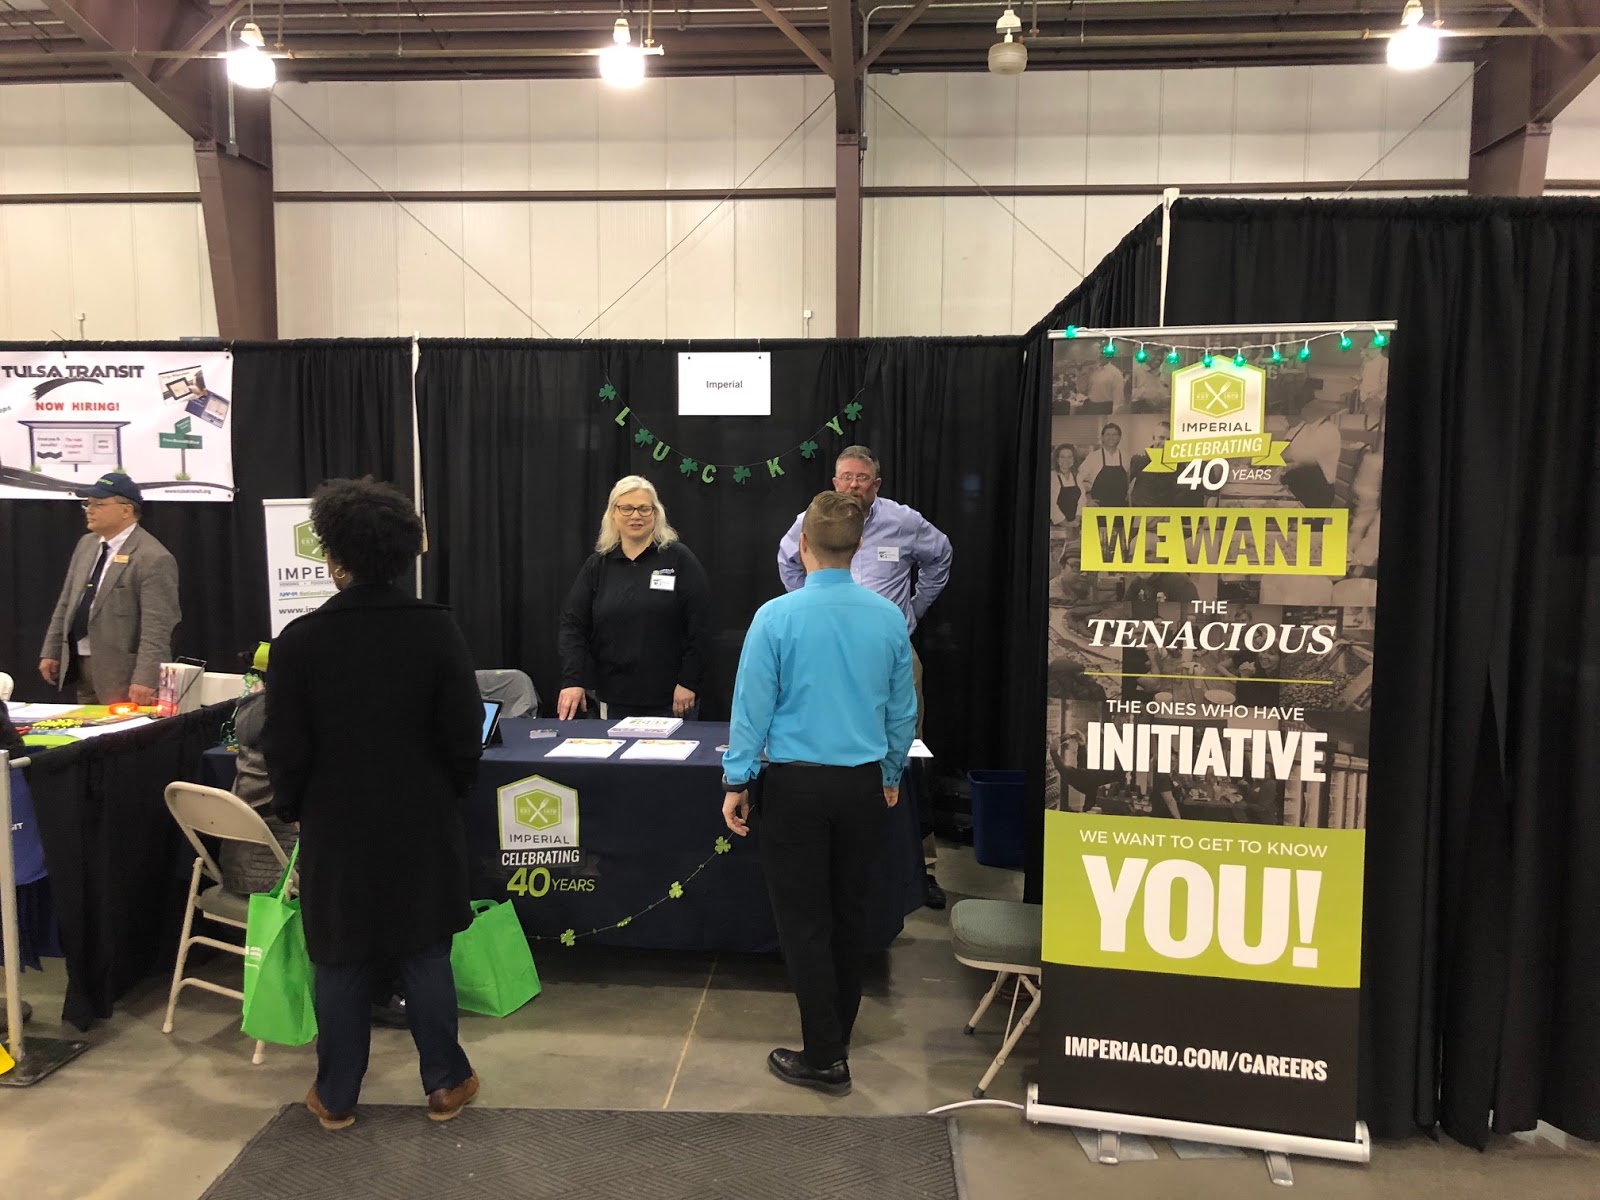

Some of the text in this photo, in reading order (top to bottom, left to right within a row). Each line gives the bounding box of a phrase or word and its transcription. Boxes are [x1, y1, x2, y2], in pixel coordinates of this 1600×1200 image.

[1, 365, 144, 378] TULSA TRANSIT
[706, 380, 743, 391] Imperial
[35, 402, 120, 411] NOW HIRING!
[1182, 422, 1252, 432] IMPERIAL
[1170, 437, 1262, 459] CELEBRATING
[1176, 458, 1272, 491] 40 YEARS
[1096, 515, 1333, 567] WE WANT
[278, 566, 332, 580] IMPE
[1191, 600, 1228, 615] THE
[1087, 619, 1336, 655] TENACIOUS
[1106, 699, 1305, 721] THE ONES WHO HAVE
[1086, 721, 1328, 782] INITIATIVE
[509, 834, 570, 845] IMPERIAL
[1079, 829, 1328, 858] WE WANT TO GET TO KNOW
[501, 849, 580, 866] CELEBRATING
[506, 867, 595, 897] 40 YEARS
[1081, 854, 1323, 969] YOU!
[1065, 1035, 1328, 1082] IMPERIALCO.COM/CAREERS
